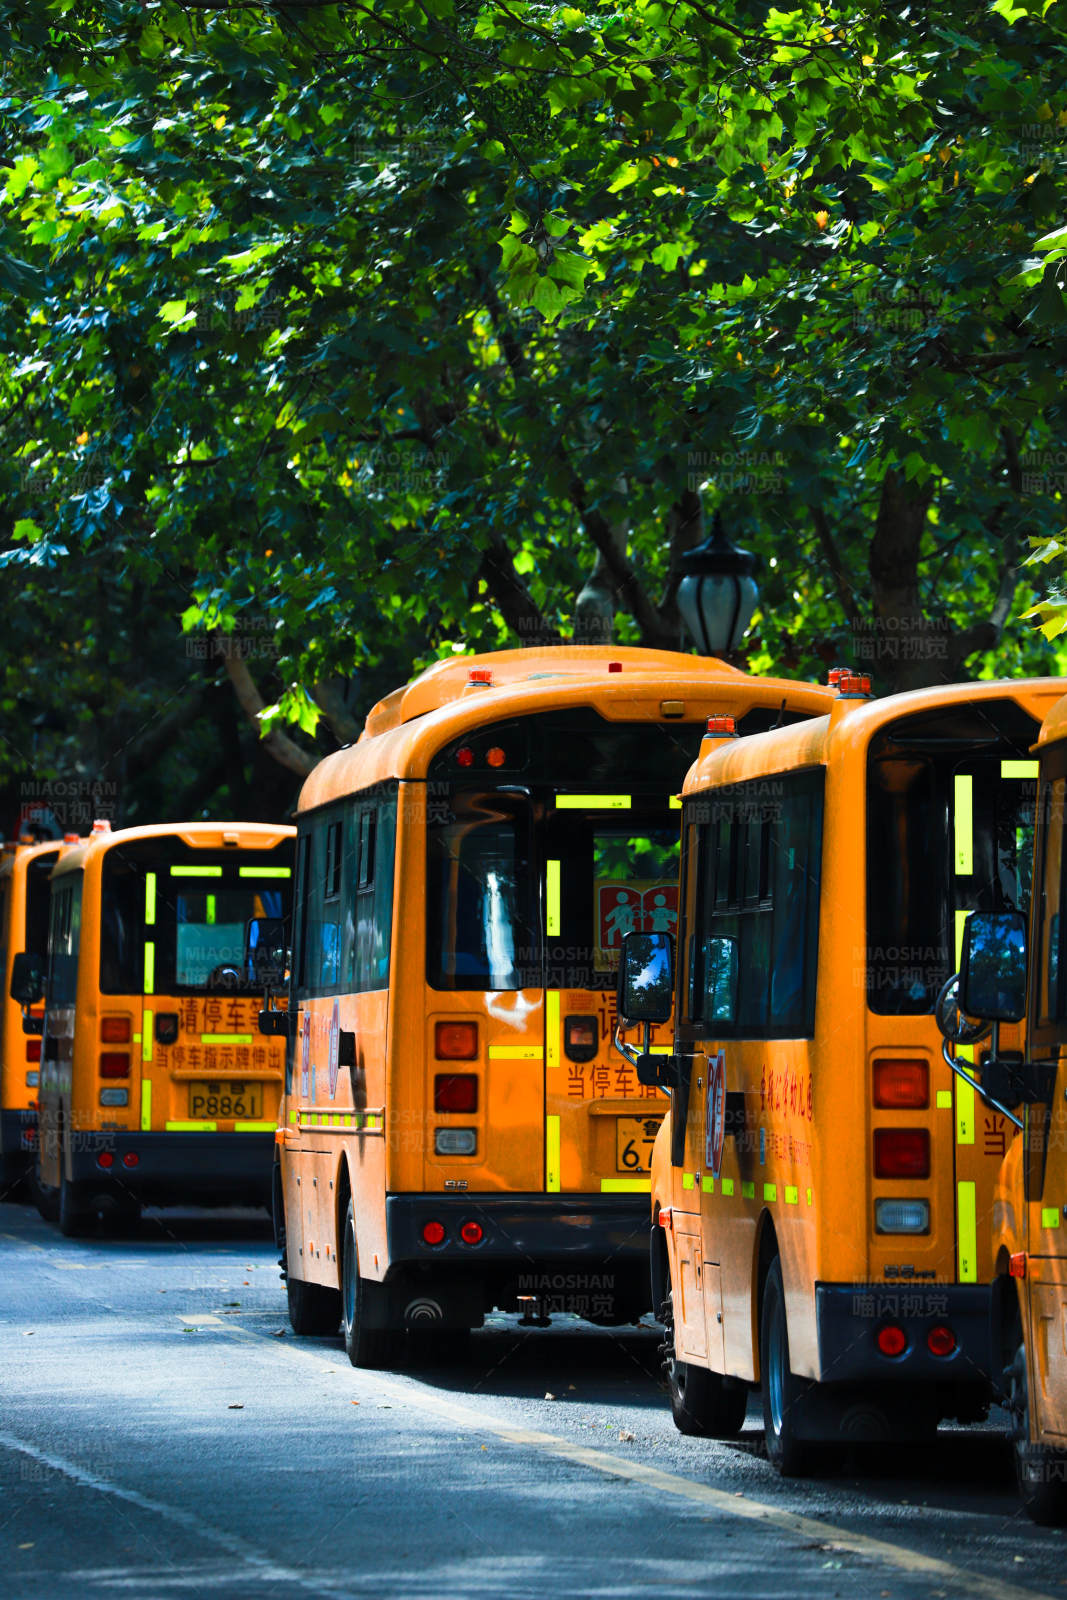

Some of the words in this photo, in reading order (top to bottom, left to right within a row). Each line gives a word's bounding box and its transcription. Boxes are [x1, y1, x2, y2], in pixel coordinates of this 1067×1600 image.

[179, 997, 288, 1033] 请停车等
[192, 1096, 255, 1116] P8861
